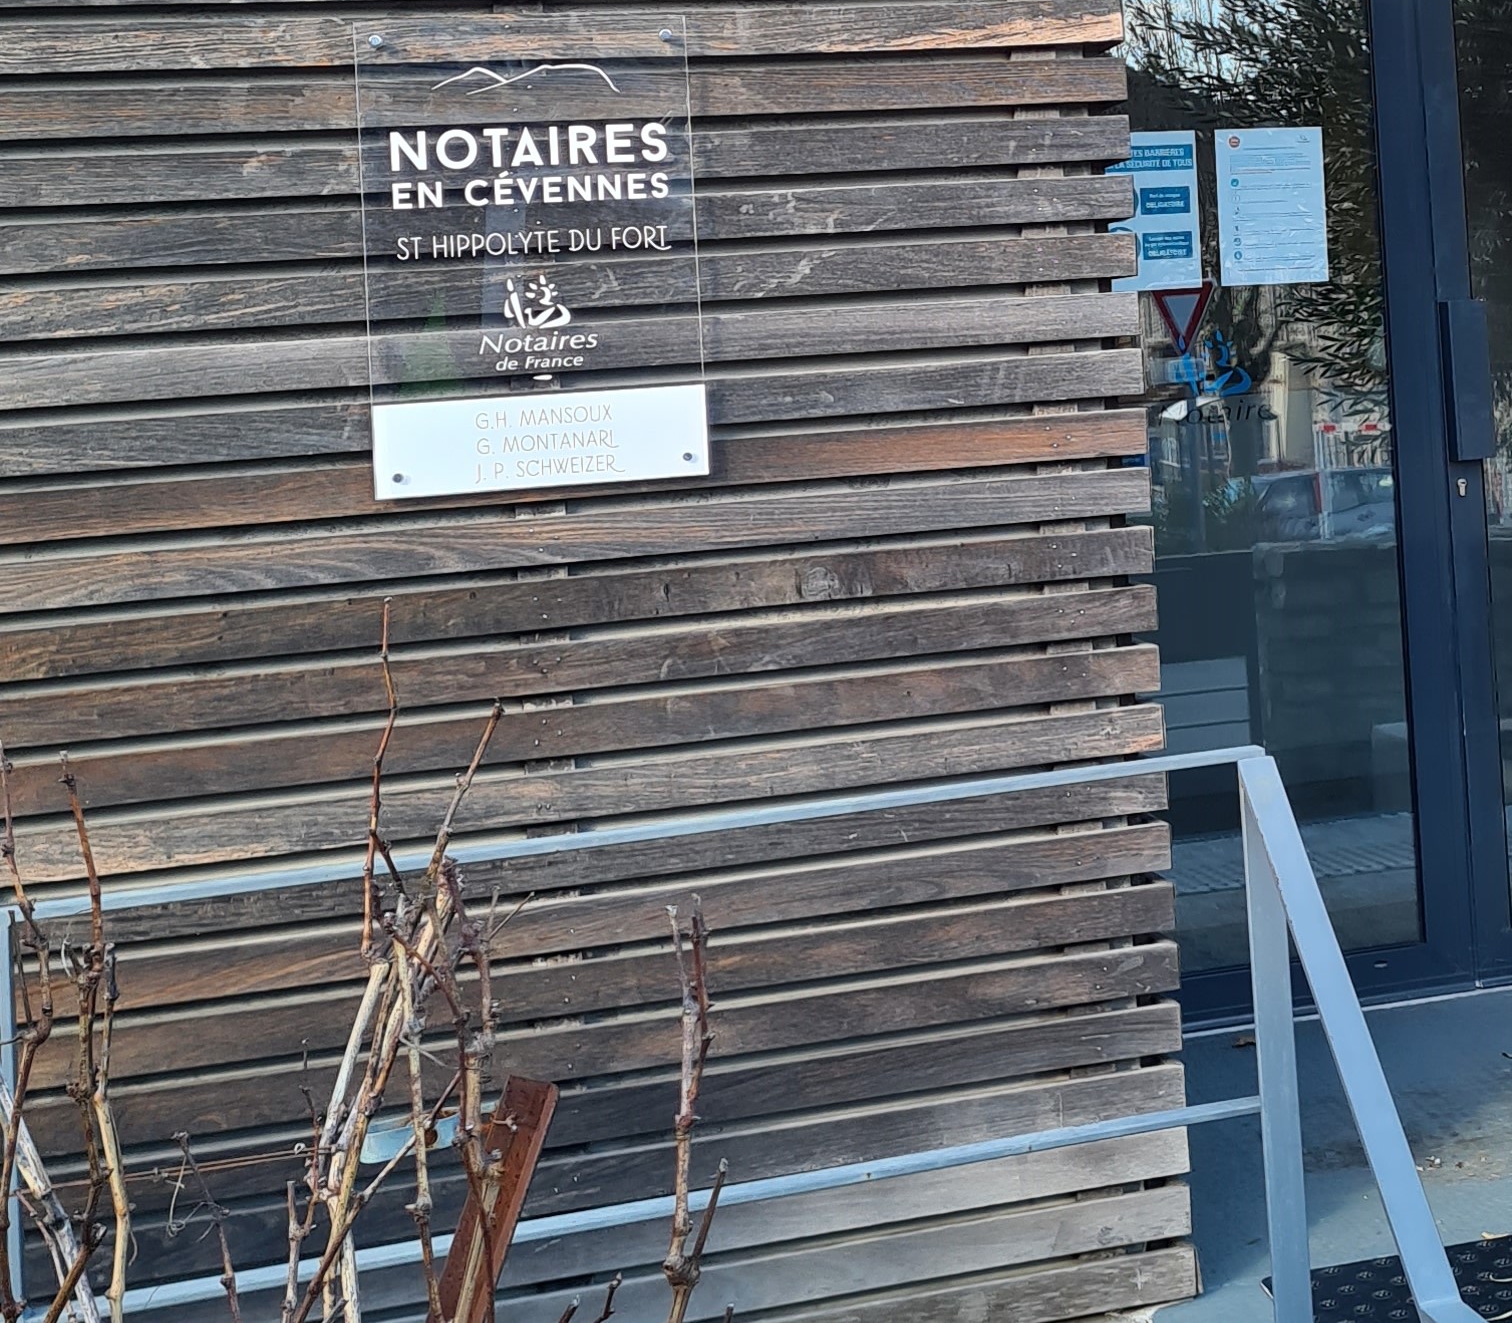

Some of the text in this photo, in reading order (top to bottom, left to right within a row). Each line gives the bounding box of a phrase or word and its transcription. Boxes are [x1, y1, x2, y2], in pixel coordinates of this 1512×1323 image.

[389, 122, 668, 172] NOTAIRES
[392, 170, 669, 210] EN CÉVENNES
[397, 225, 672, 261] ST HIPPOLYTE DU FORT
[479, 330, 599, 355] Notaires
[495, 355, 584, 371] de France
[519, 404, 613, 427] MANSOUX
[476, 429, 620, 455] G. MONTANARI
[475, 454, 627, 484] J. P. SCHWEIZER
